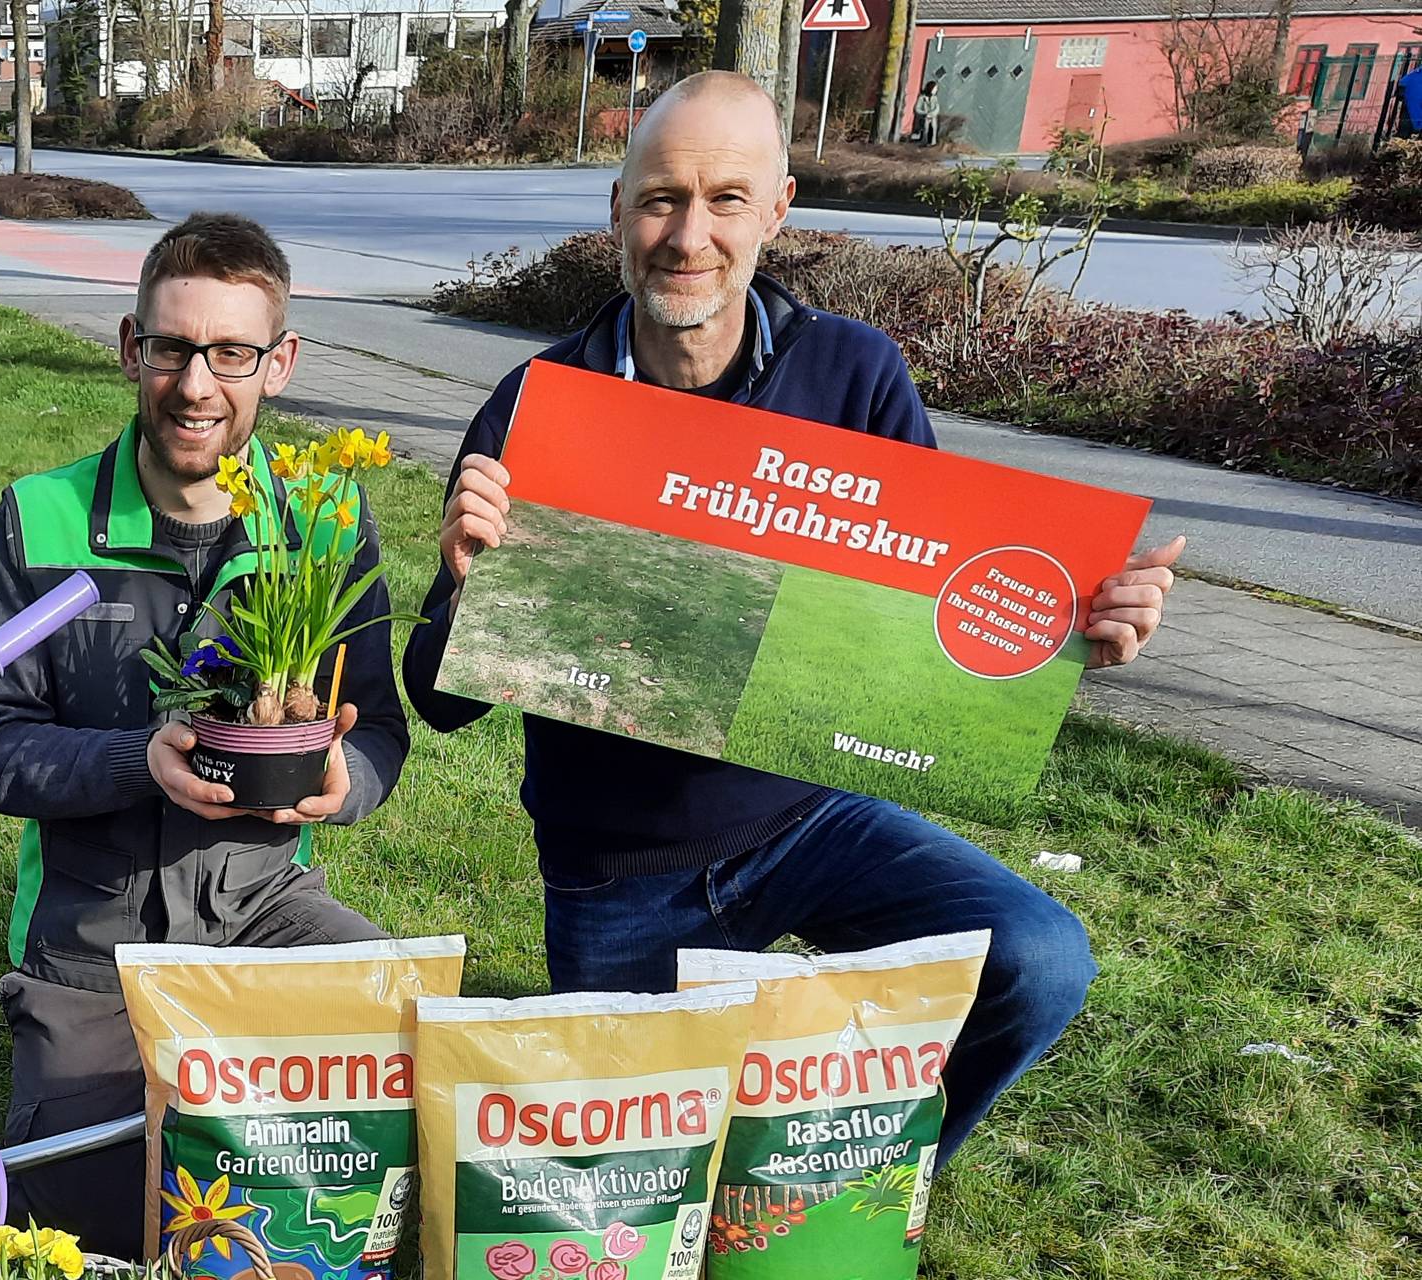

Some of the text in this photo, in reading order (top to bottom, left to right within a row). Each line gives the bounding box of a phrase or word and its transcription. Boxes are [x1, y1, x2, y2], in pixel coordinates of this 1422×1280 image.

[752, 447, 881, 506] Rasen
[658, 472, 949, 567] Frühjahrskur
[970, 584, 1056, 627] sich nun auf
[986, 568, 1058, 608] Freuen Sie
[946, 592, 1054, 649] Ihren Rasen wie
[958, 620, 1023, 655] nie zuvor
[566, 666, 612, 692] Ist?
[215, 761, 235, 771] my
[832, 732, 936, 772] Wunsch?
[177, 1049, 414, 1105] Oscorna
[244, 1115, 350, 1147] Animalin
[786, 1108, 905, 1147] Rasaflor
[215, 1146, 379, 1179] Gartendünger
[769, 1139, 913, 1176] Rasendünger
[501, 1165, 691, 1201] BodenAktivator
[501, 1205, 516, 1215] Auf
[621, 1197, 656, 1210] gesunde
